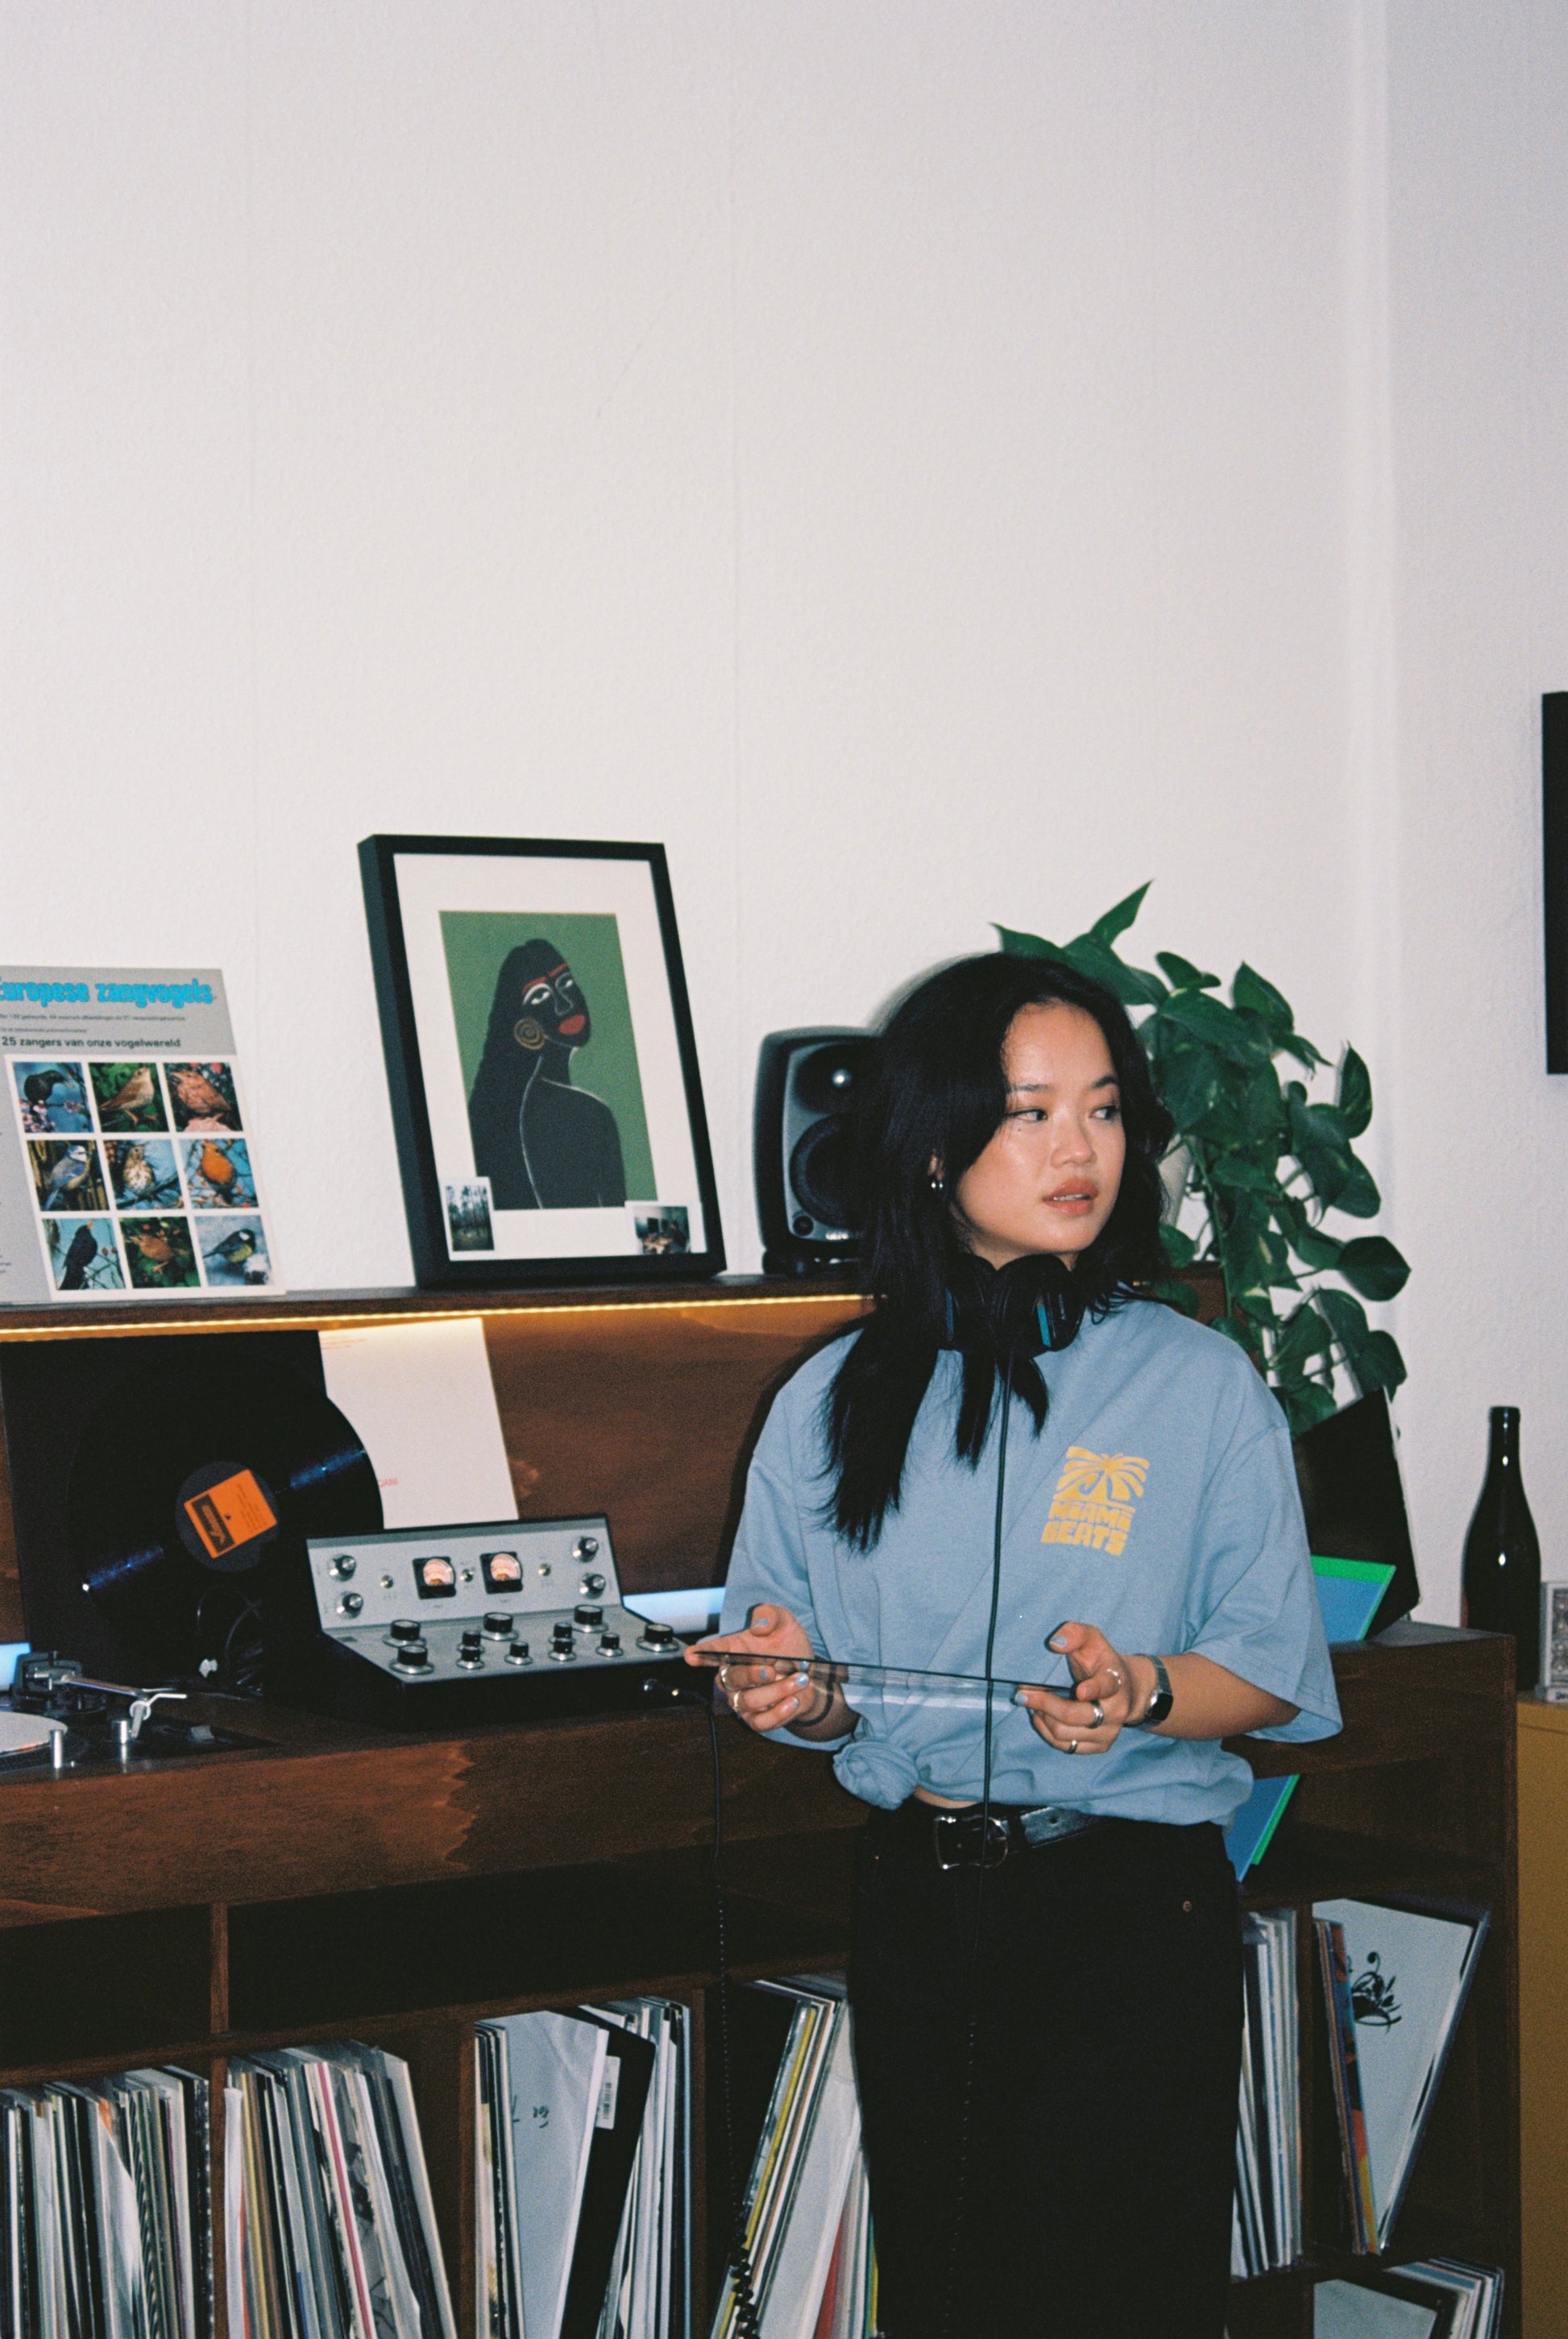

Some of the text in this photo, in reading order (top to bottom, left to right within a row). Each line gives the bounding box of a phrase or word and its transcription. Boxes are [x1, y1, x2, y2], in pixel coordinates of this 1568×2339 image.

[0, 977, 214, 1009] uropese zangvogels
[1, 1035, 181, 1049] 25 zangers van onze vogelwereld
[1047, 1500, 1134, 1532] MIAMI
[1039, 1520, 1129, 1557] BEATS
